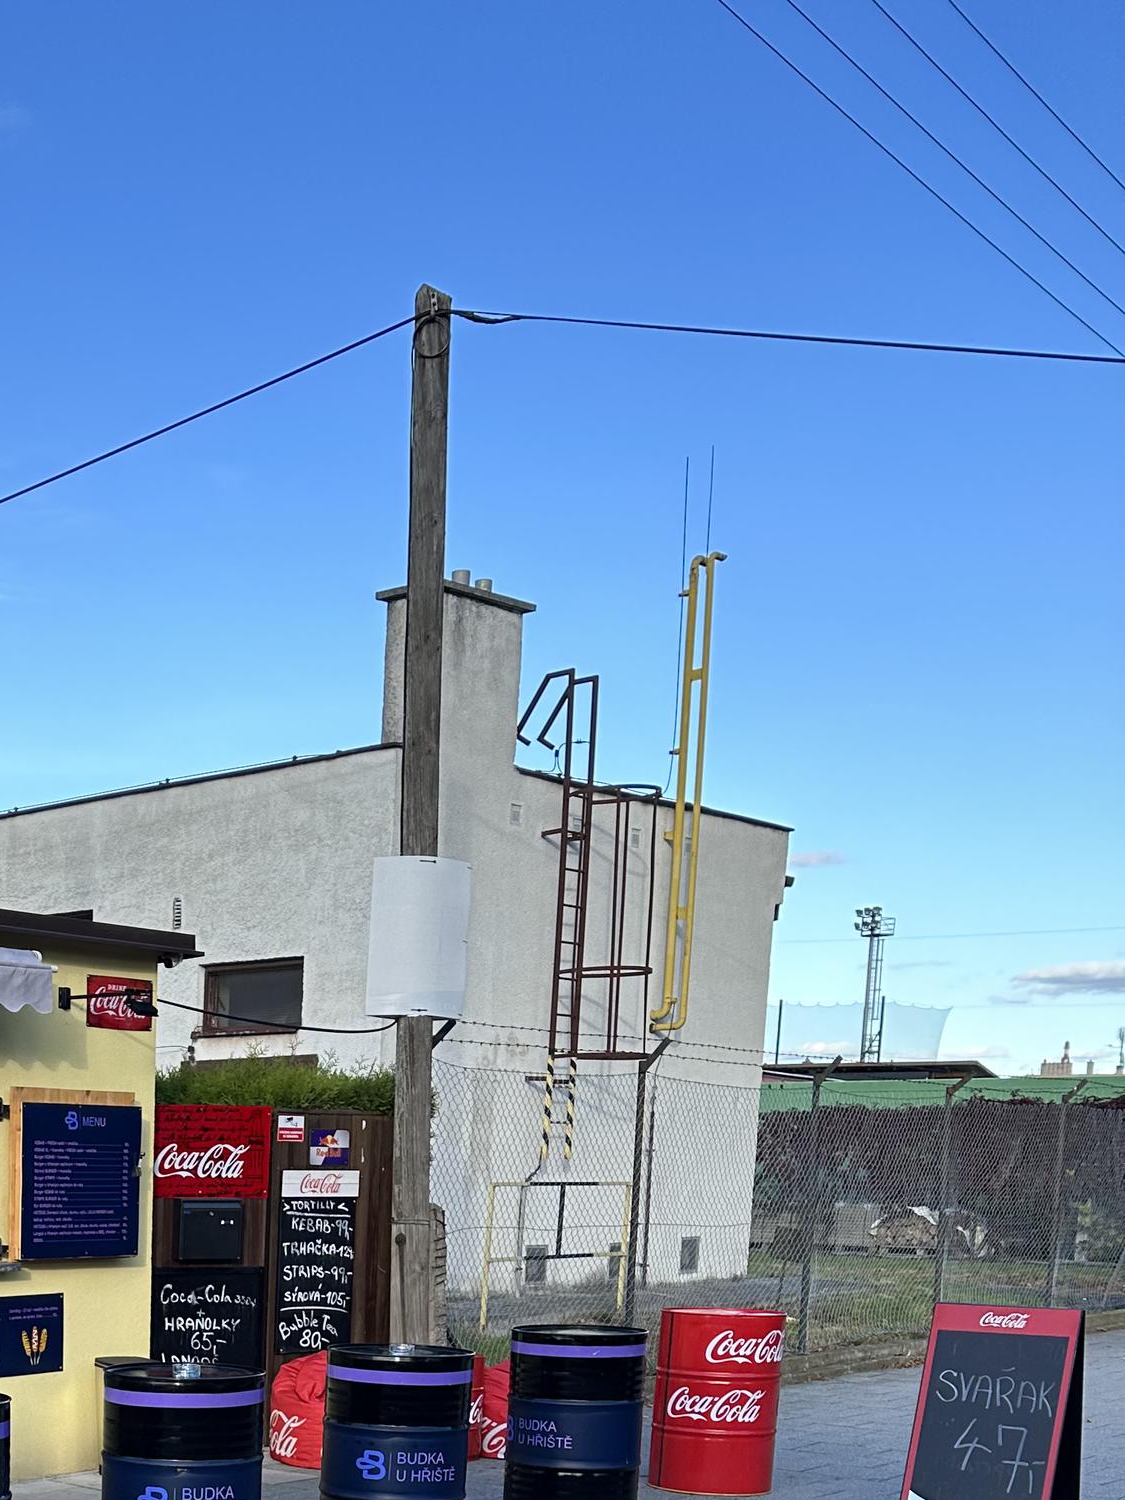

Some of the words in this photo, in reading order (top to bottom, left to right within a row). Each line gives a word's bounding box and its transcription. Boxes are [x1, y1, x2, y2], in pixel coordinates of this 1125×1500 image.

[82, 1116, 107, 1127] MENU
[154, 1143, 251, 1179] Coca-Cola
[300, 1173, 344, 1194] Coca-Cola
[160, 1283, 232, 1305] Coca-Cola
[164, 1316, 241, 1332] HRANOLKY
[278, 1310, 319, 1341] Bubble
[322, 1314, 339, 1337] Tea
[979, 1311, 1031, 1329] Coca-Cola
[935, 1366, 1055, 1418] SVAŘAK
[666, 1386, 767, 1423] Coca-Cola
[518, 1417, 557, 1433] BUDKA
[518, 1433, 525, 1444] U
[527, 1434, 573, 1449] HŘIŠTĚ
[396, 1452, 445, 1465] BUDKA
[395, 1470, 406, 1482] U
[410, 1465, 456, 1482] HŘIŠTĚ
[182, 1485, 234, 1500] BUDKA
